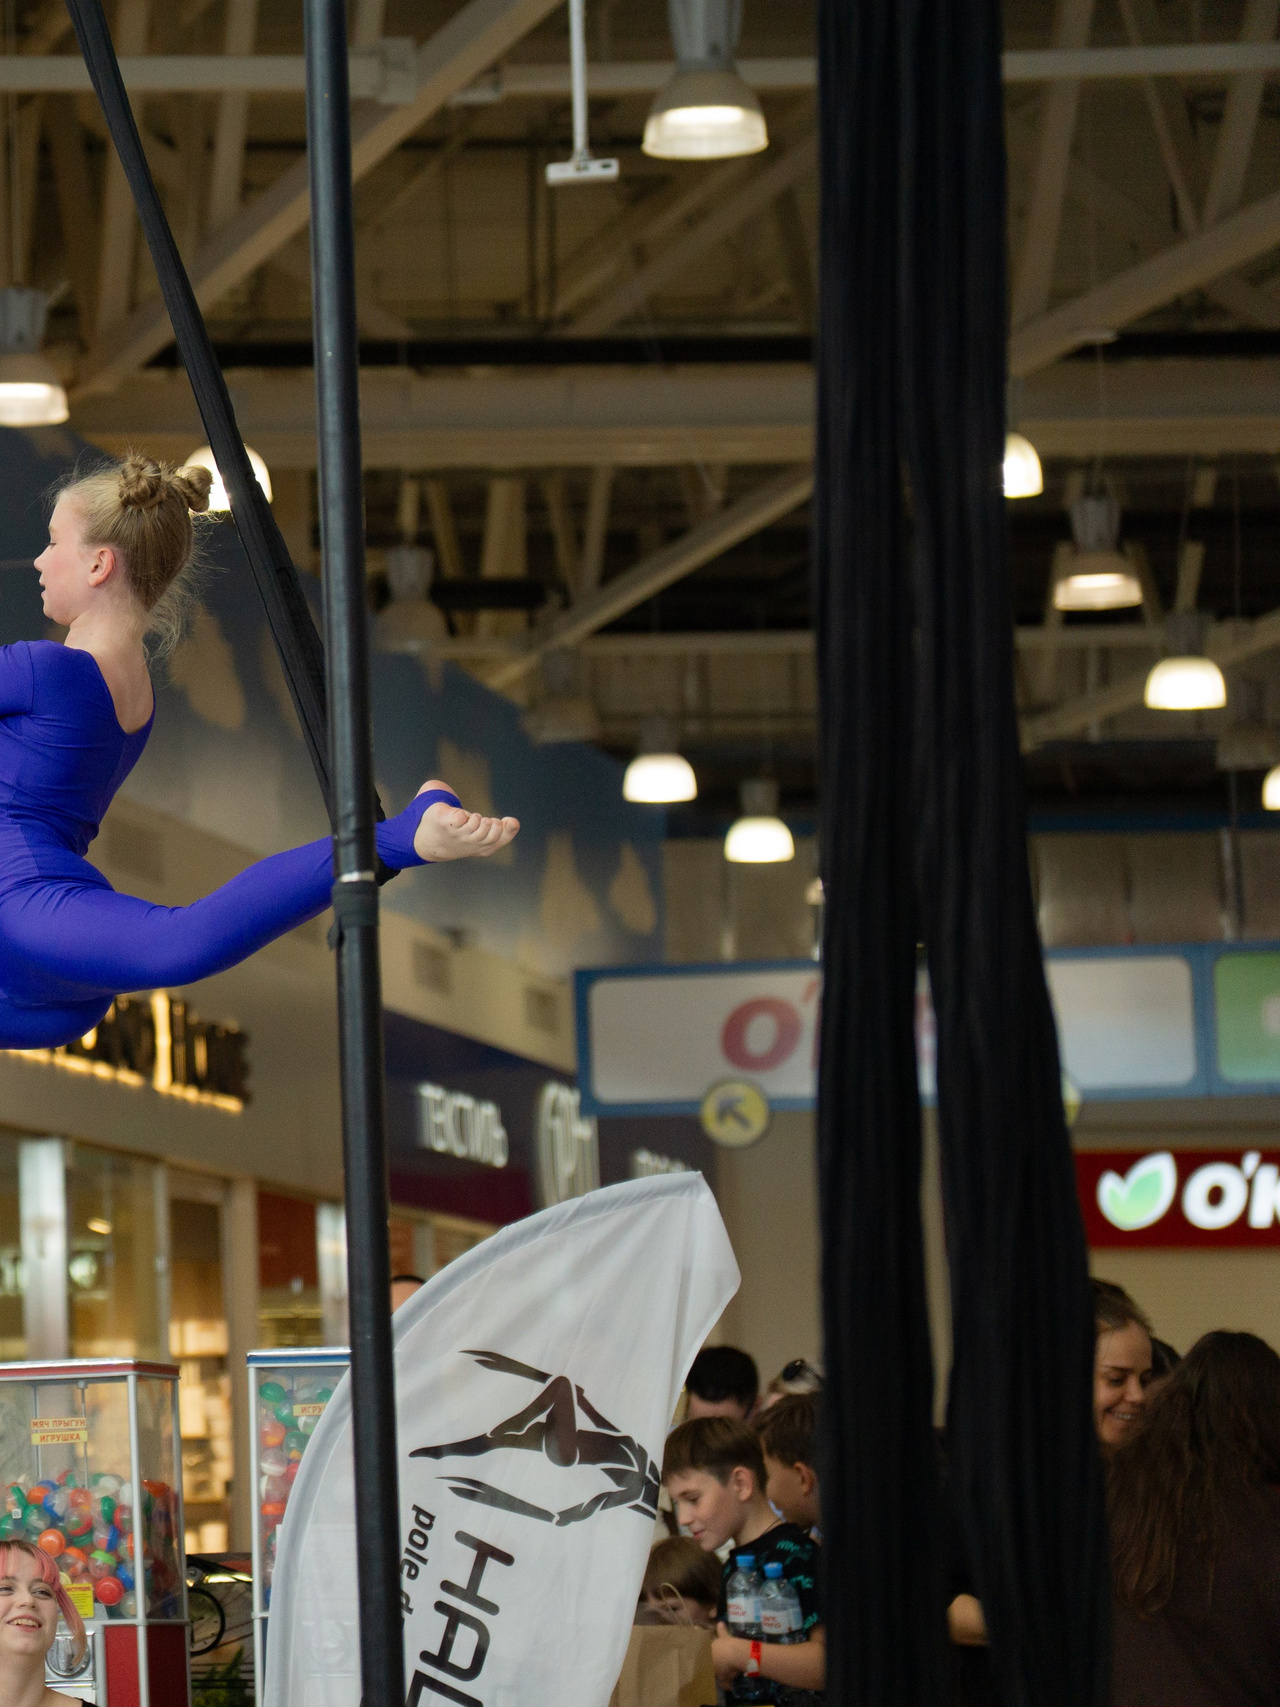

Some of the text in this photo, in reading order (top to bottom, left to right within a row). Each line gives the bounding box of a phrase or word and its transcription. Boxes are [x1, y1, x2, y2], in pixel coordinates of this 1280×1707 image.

[300, 1405, 325, 1414] ИГРУ
[32, 1418, 86, 1429] МЯЧ ПРЫГУН
[40, 1432, 81, 1443] ИГРУШКА
[400, 1504, 436, 1581] pole
